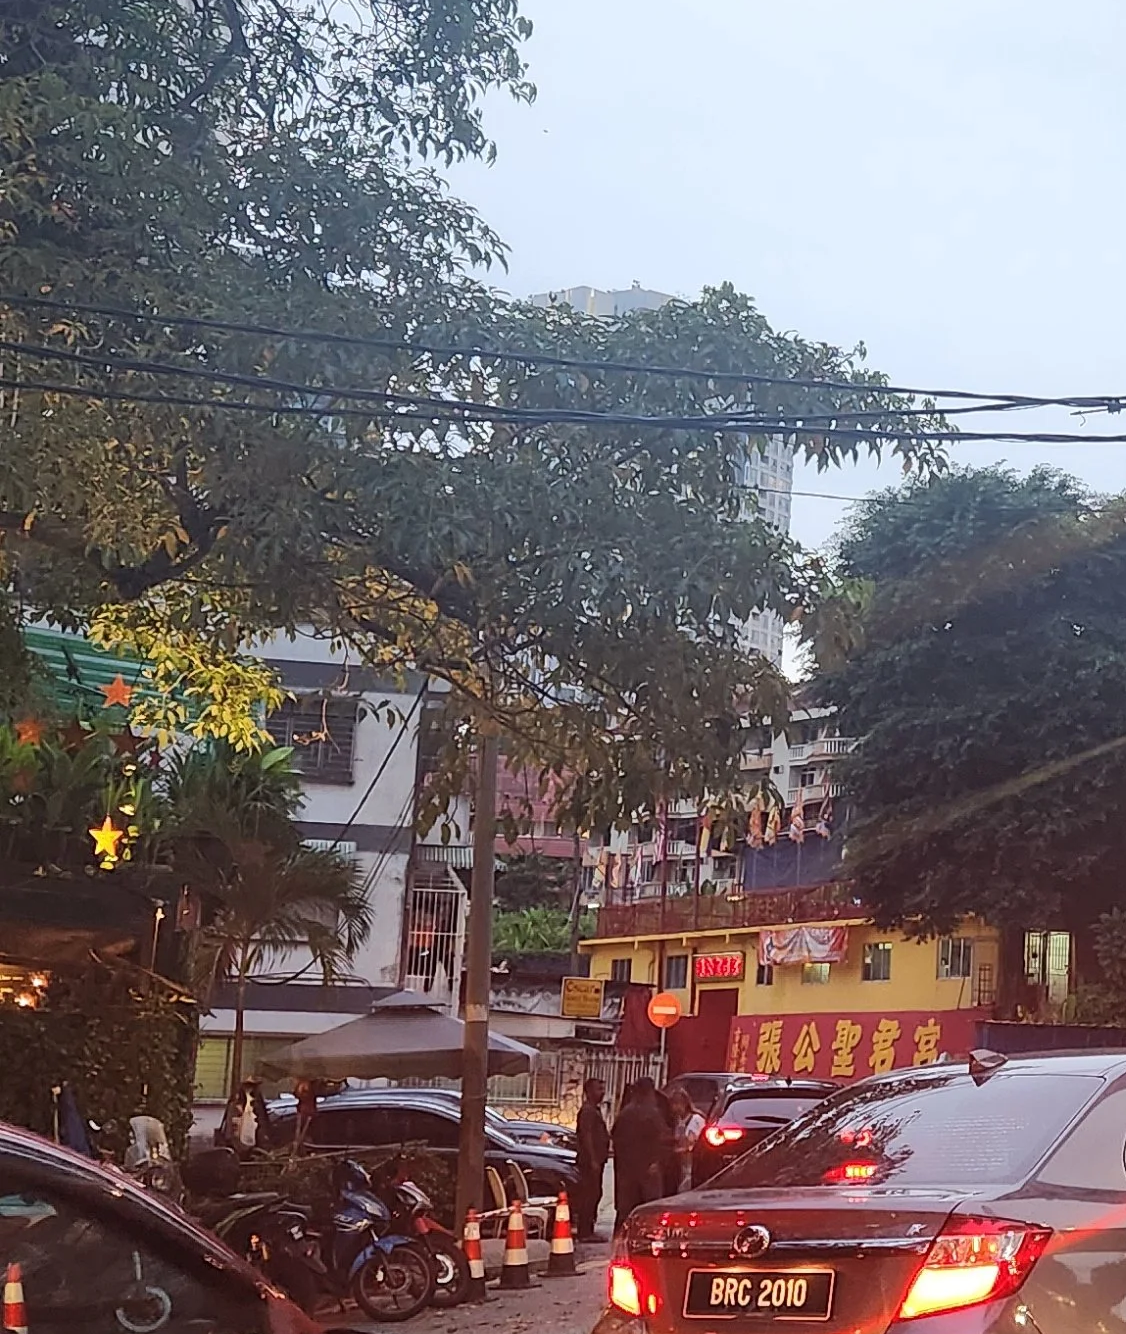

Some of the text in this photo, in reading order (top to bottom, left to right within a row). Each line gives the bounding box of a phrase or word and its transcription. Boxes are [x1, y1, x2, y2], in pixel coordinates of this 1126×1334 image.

[756, 1018, 941, 1078] 張公聖君宮
[710, 1278, 807, 1308] BRC 2010
